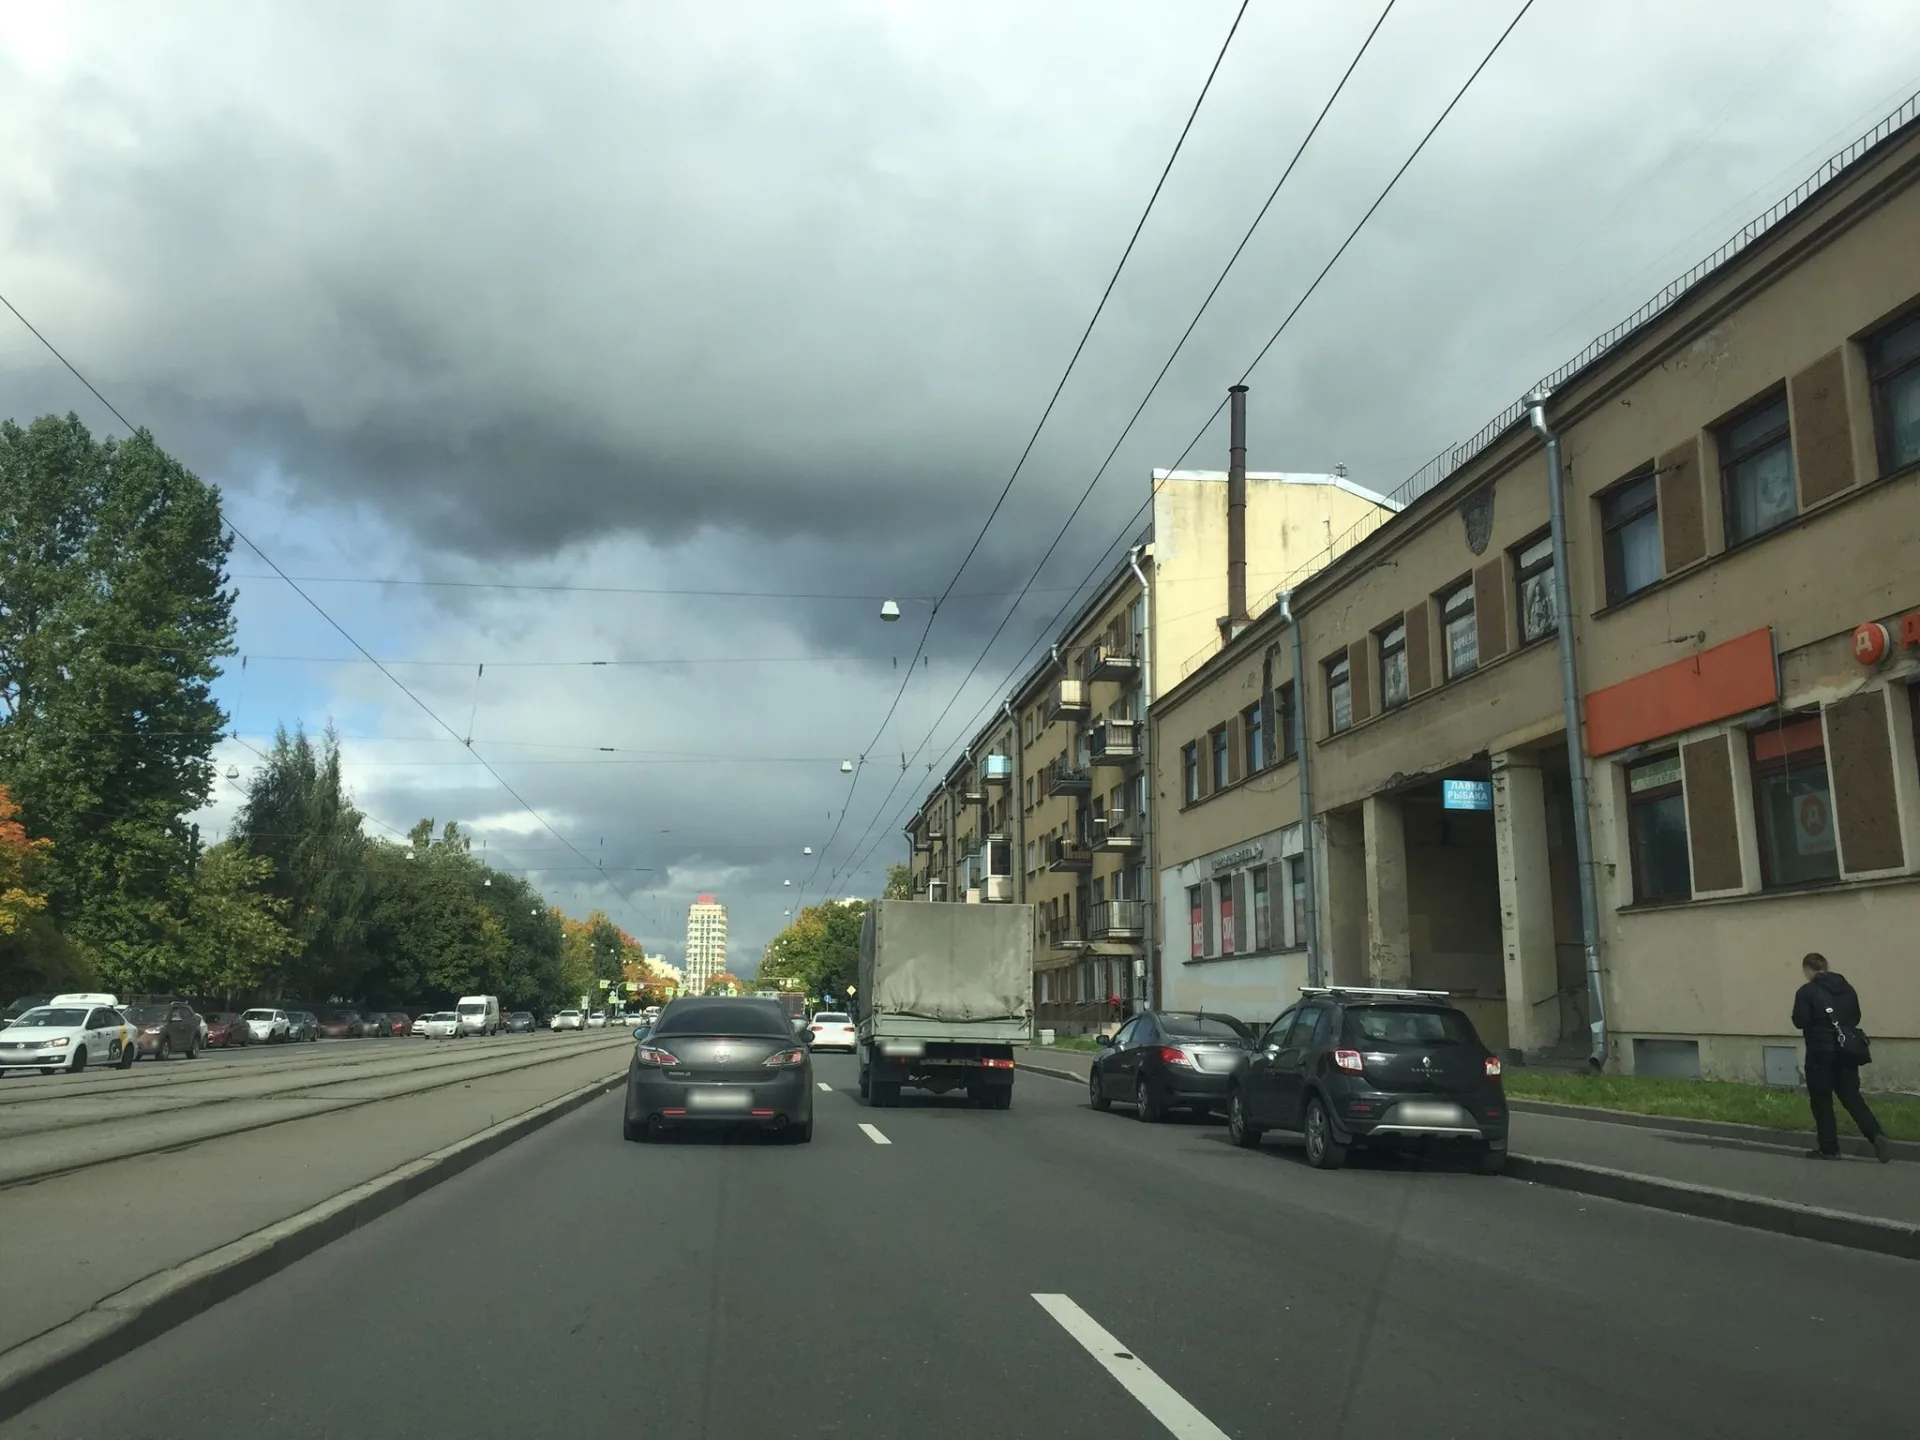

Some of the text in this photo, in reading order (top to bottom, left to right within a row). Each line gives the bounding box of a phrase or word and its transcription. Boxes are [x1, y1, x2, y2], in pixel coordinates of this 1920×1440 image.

[1856, 631, 1873, 655] Д
[1450, 781, 1485, 791] ЛАВКА
[1447, 790, 1488, 801] РЫБАКА
